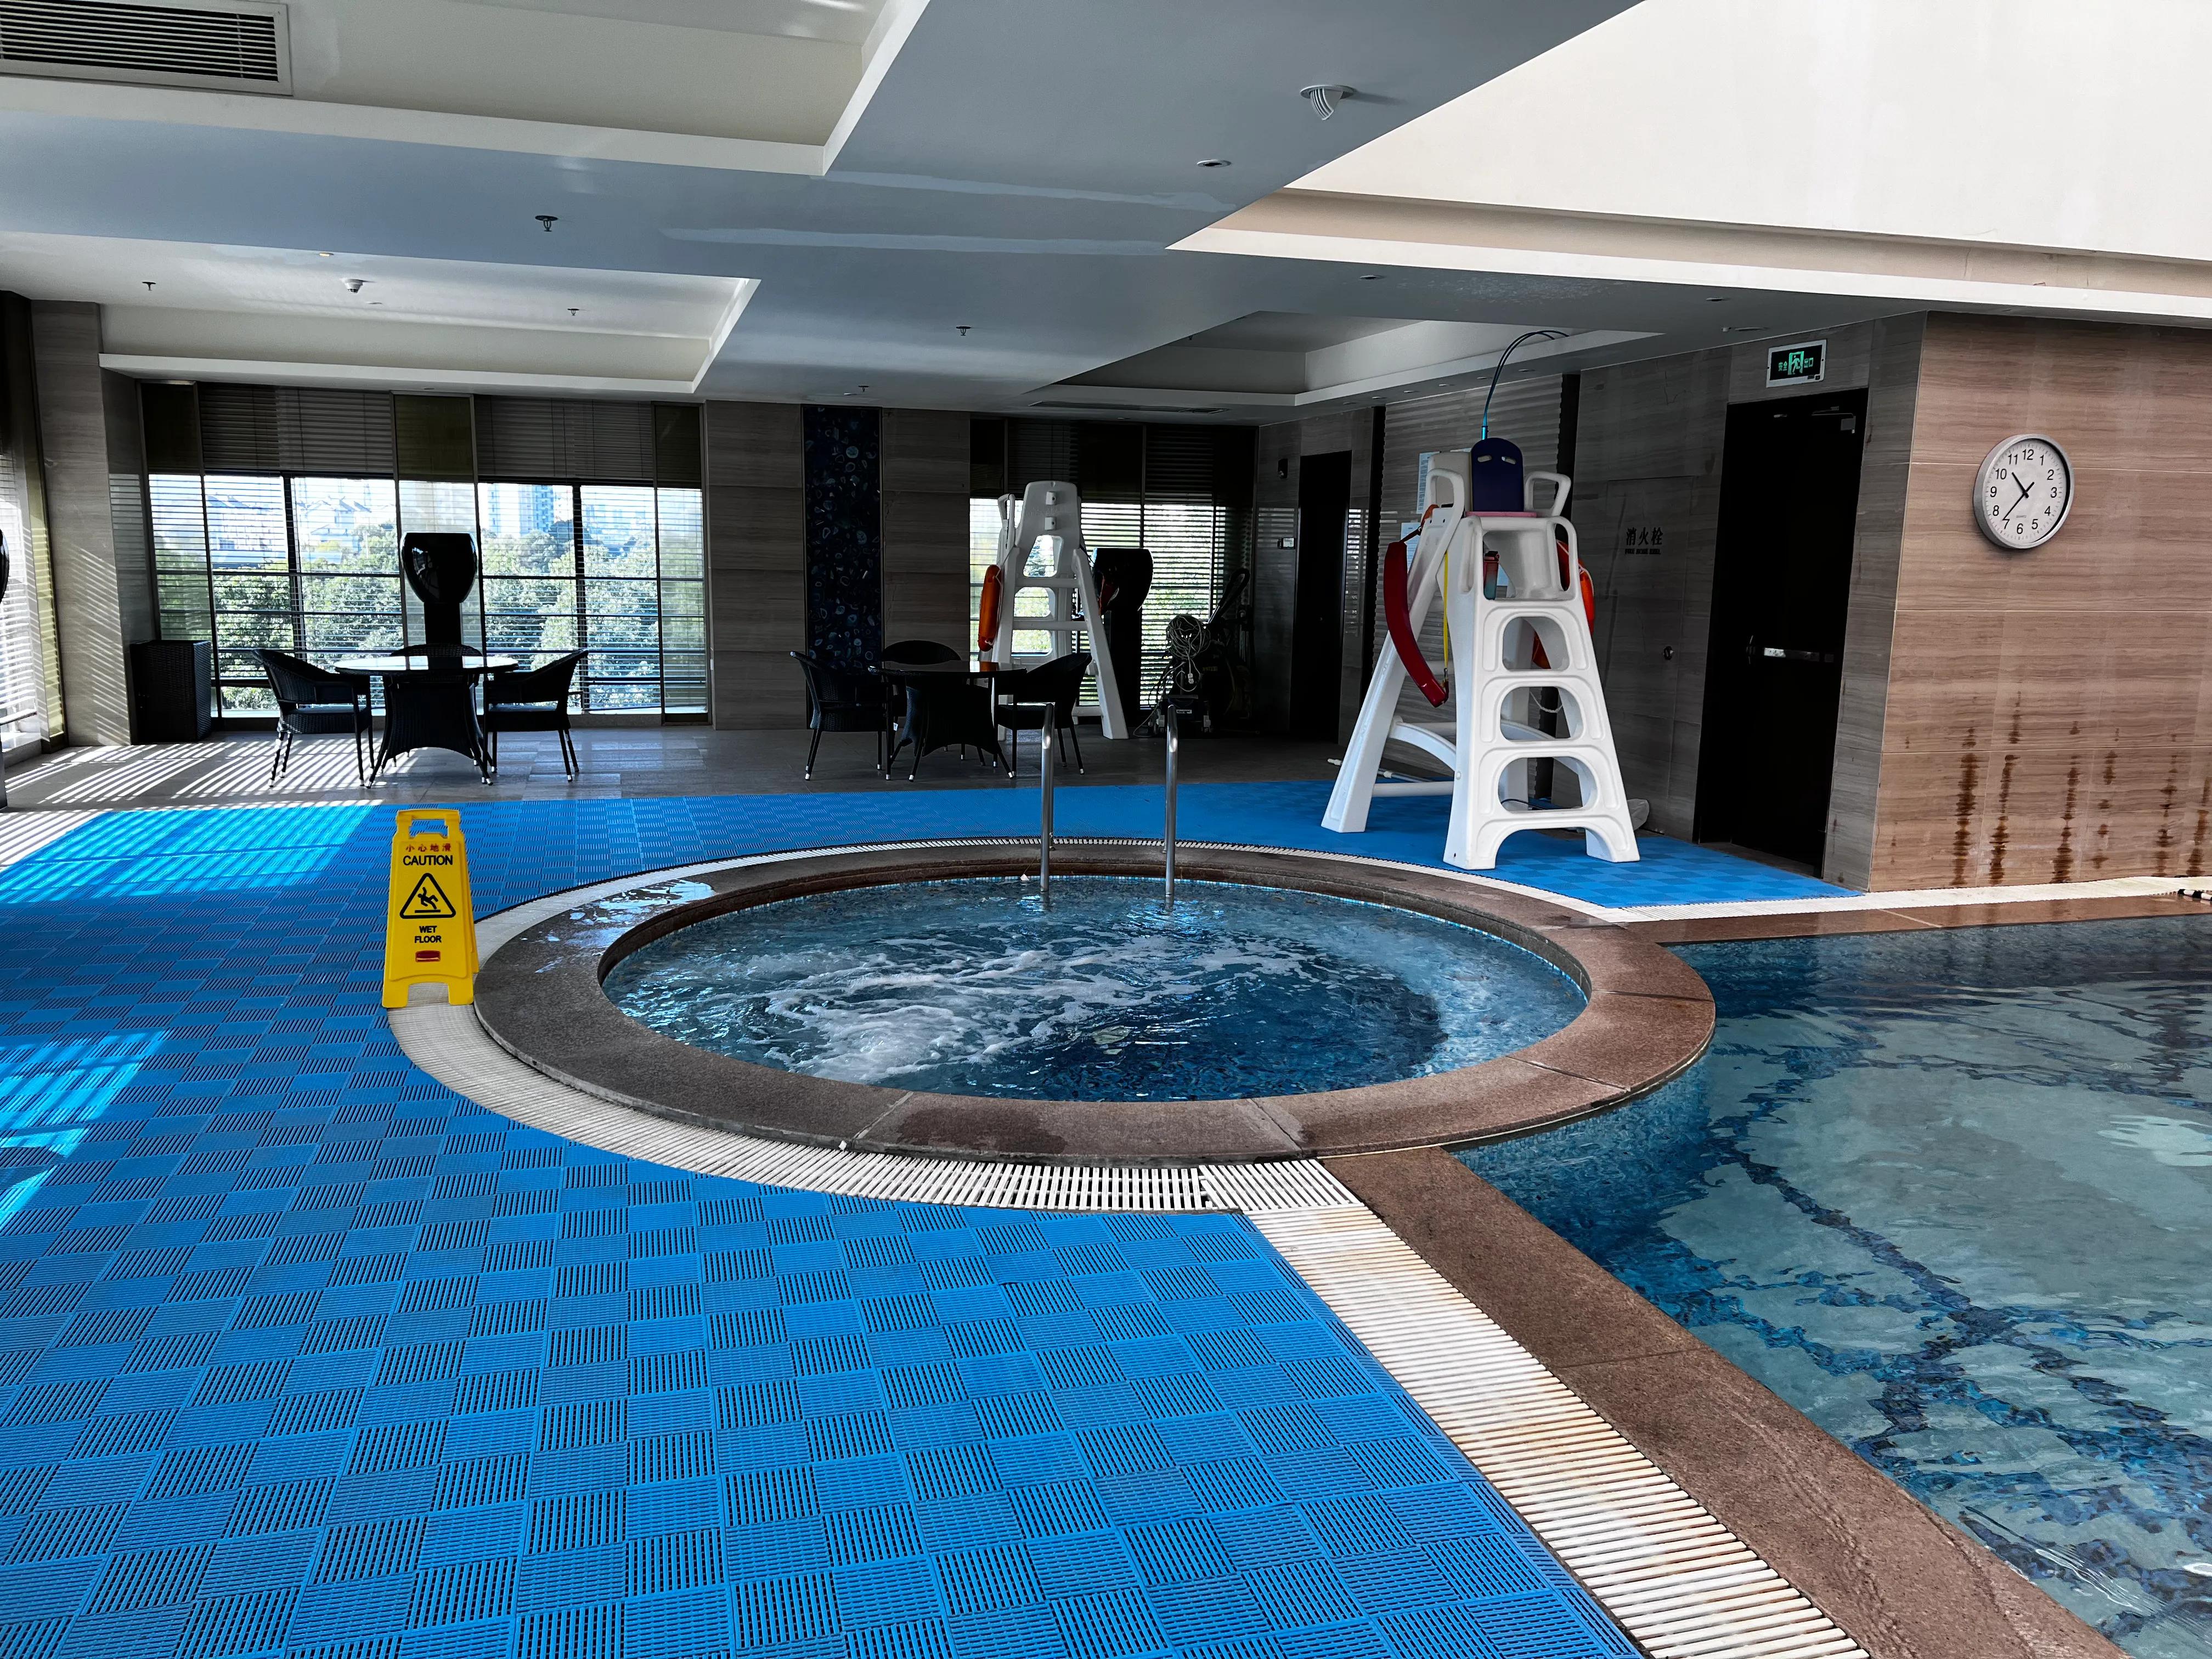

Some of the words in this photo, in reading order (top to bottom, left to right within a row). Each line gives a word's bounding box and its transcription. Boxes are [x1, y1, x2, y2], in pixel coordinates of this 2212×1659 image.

[2008, 454, 2018, 465] 11
[2022, 449, 2034, 460] 12
[2040, 455, 2045, 466] 1
[1995, 469, 2007, 479] 10
[2047, 469, 2055, 481] 2
[1990, 486, 1997, 498] 9
[2050, 487, 2057, 498] 3
[1993, 505, 2000, 516] 8
[2044, 506, 2051, 516] 4
[2002, 519, 2010, 529] 7
[2017, 523, 2023, 534] 6
[2032, 518, 2039, 529] 5
[1626, 527, 1663, 545] 消火栓
[405, 843, 452, 852] 小心地滑
[403, 855, 453, 866] CAUTION
